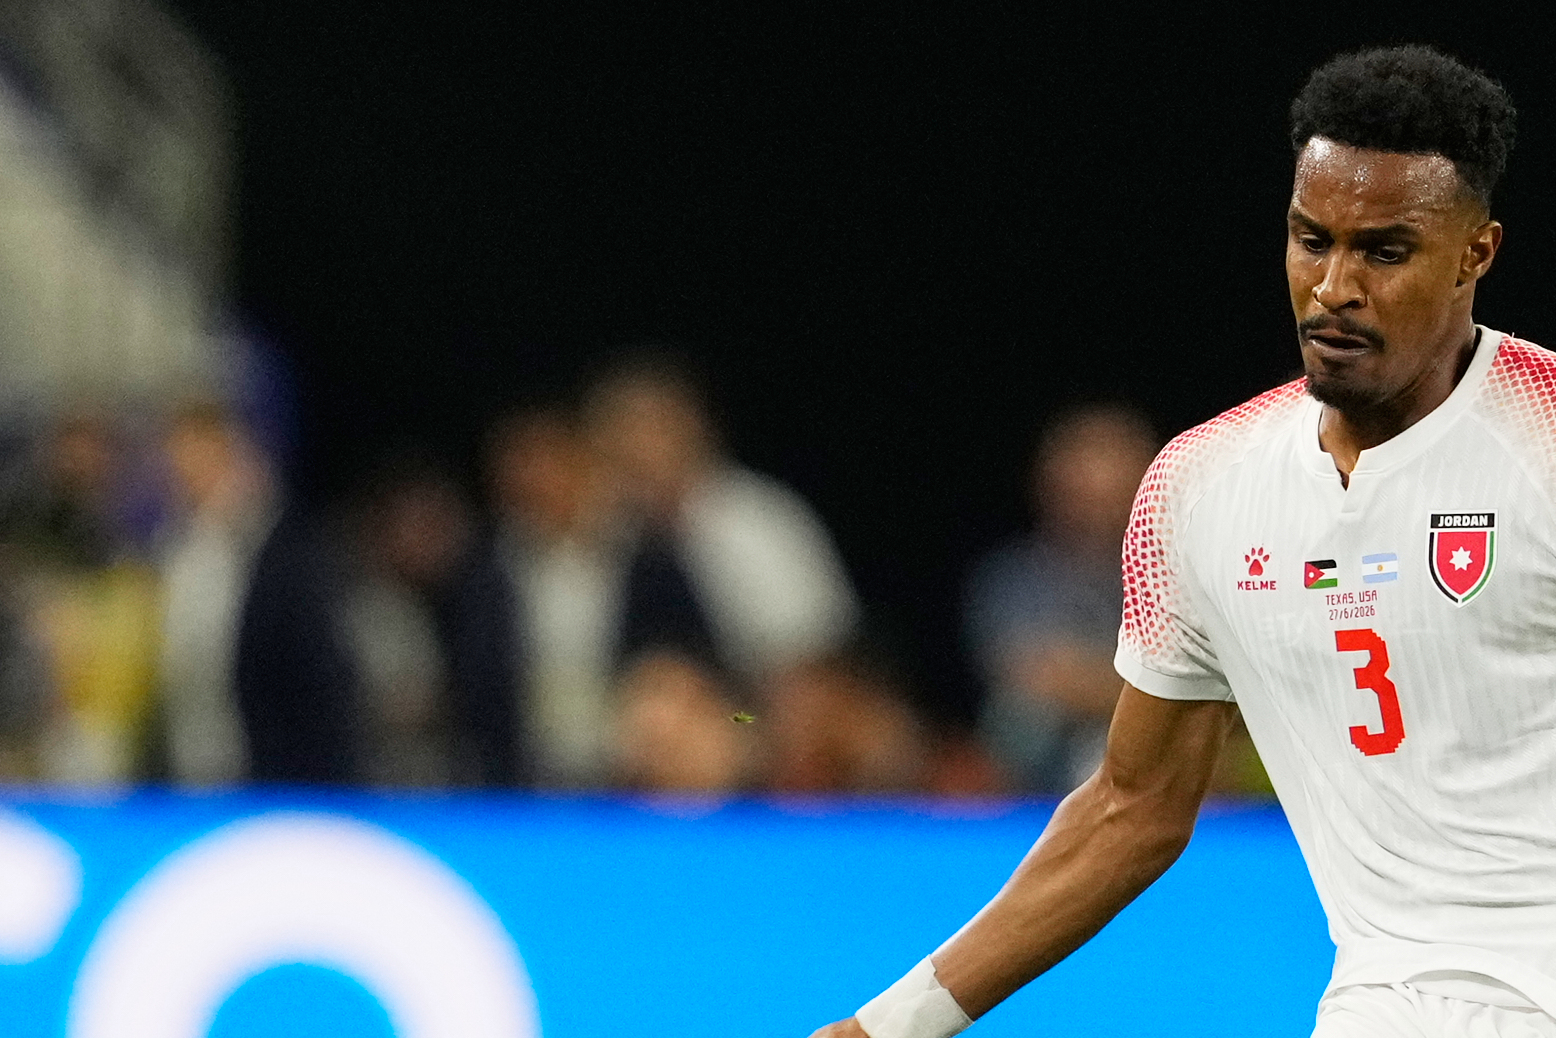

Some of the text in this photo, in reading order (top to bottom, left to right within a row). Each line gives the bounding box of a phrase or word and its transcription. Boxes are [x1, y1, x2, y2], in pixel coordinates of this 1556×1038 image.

[1437, 515, 1489, 527] JORDAN
[1237, 580, 1277, 591] KELME
[1325, 589, 1378, 606] TEXAS, USA
[1328, 604, 1376, 621] 27/6/2026
[1335, 628, 1406, 757] 3
